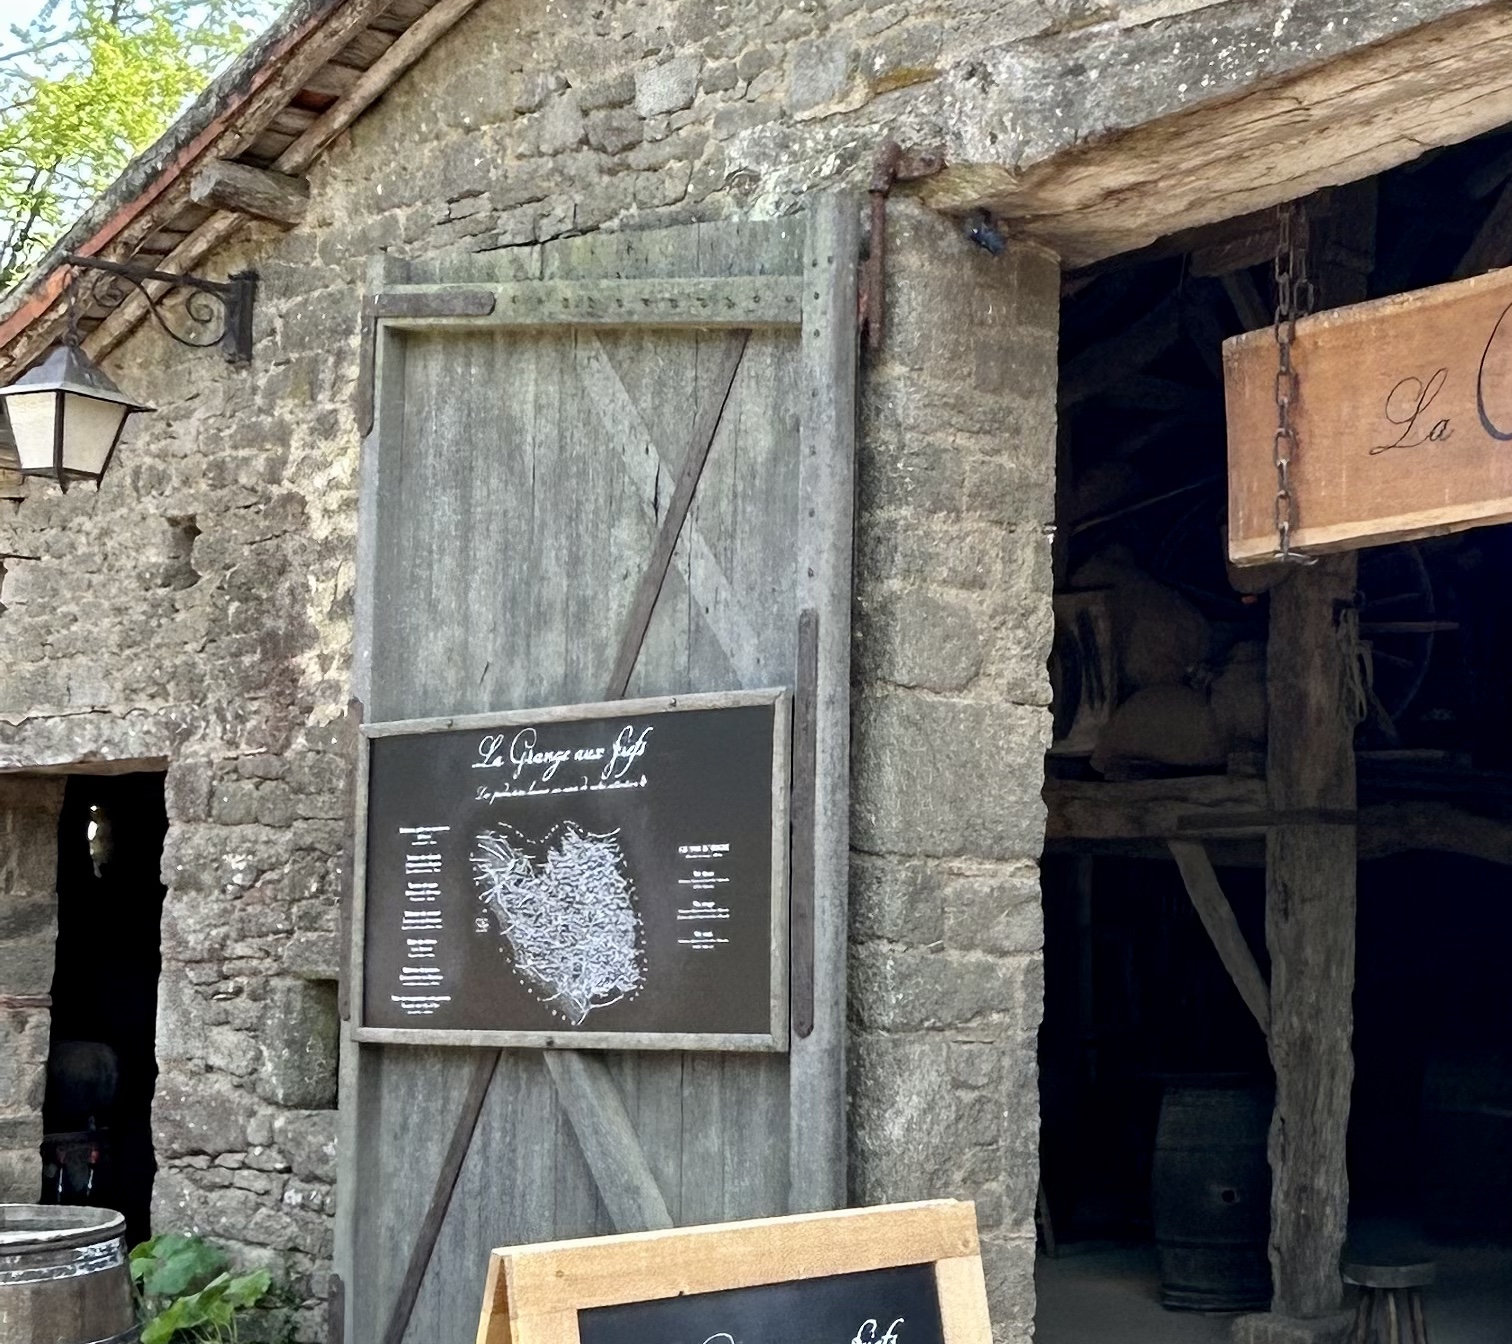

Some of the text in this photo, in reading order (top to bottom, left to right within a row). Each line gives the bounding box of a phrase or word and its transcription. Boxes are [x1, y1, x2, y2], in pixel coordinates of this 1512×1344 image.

[1369, 368, 1453, 456] La
[471, 734, 505, 769] La
[509, 728, 571, 782] Grange
[573, 747, 605, 761] aux
